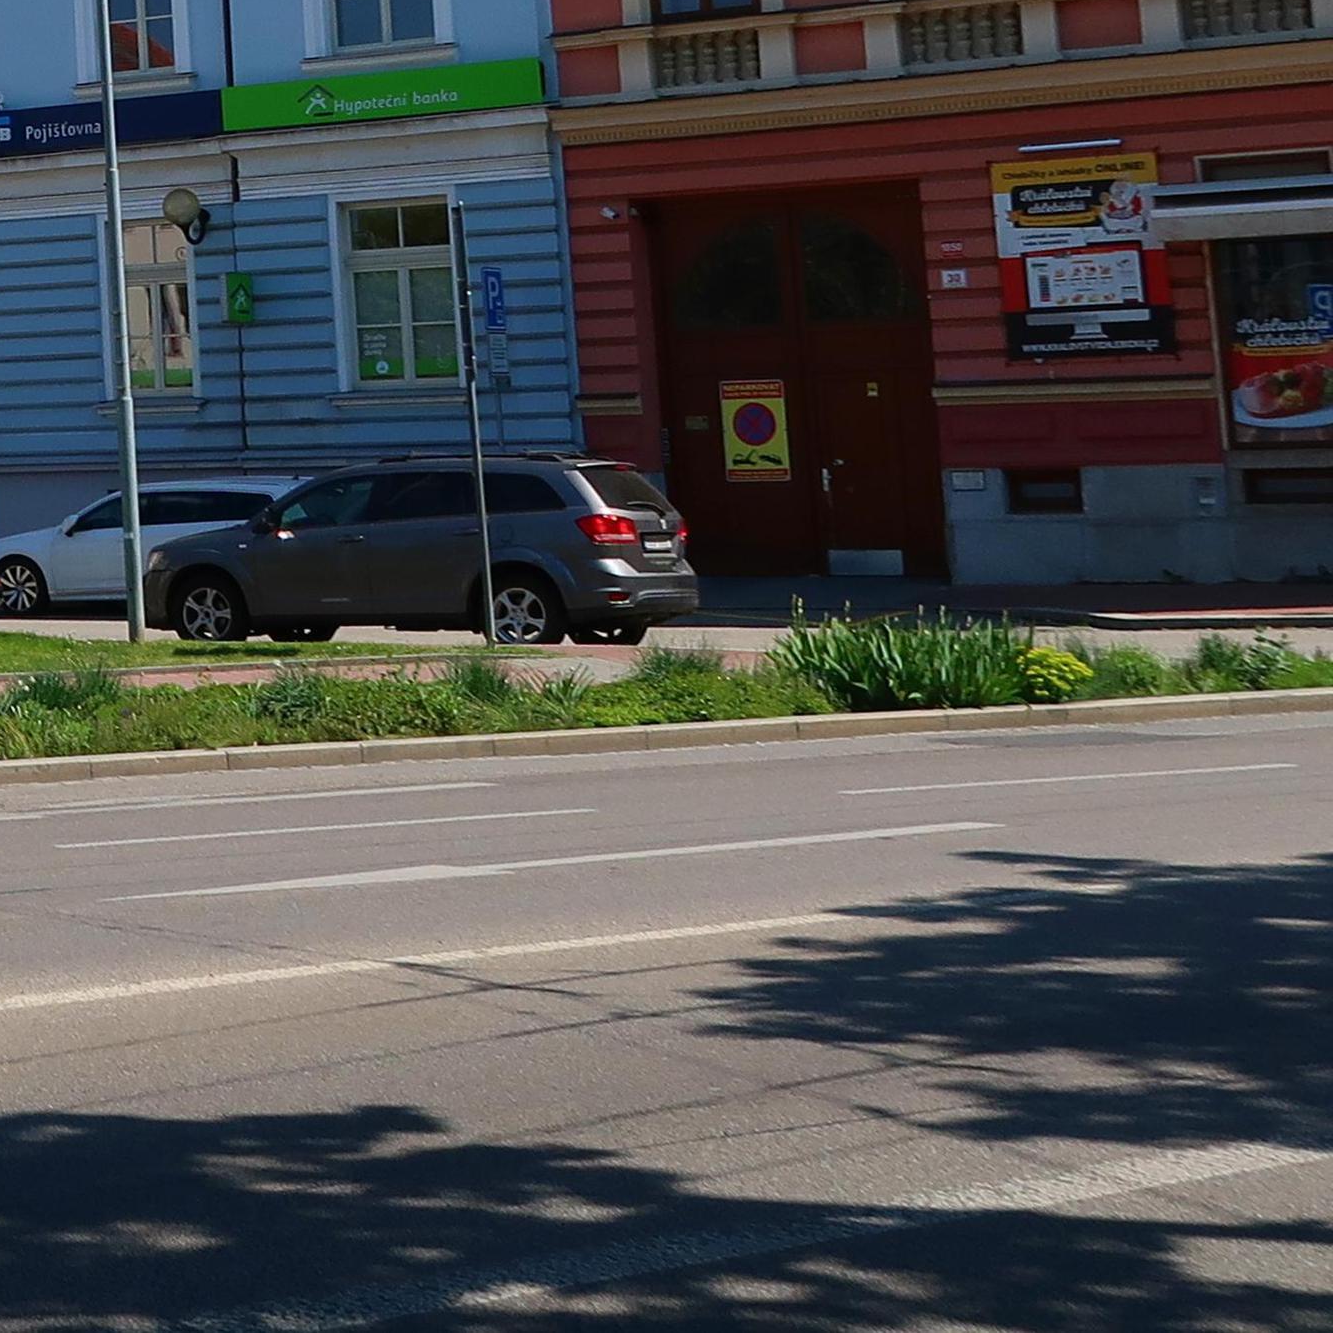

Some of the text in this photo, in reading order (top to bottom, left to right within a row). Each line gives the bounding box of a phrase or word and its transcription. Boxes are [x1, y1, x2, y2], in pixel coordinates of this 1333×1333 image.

[334, 89, 458, 115] Hypoteční banka
[25, 122, 102, 144] Pojišťovna
[487, 276, 500, 309] P
